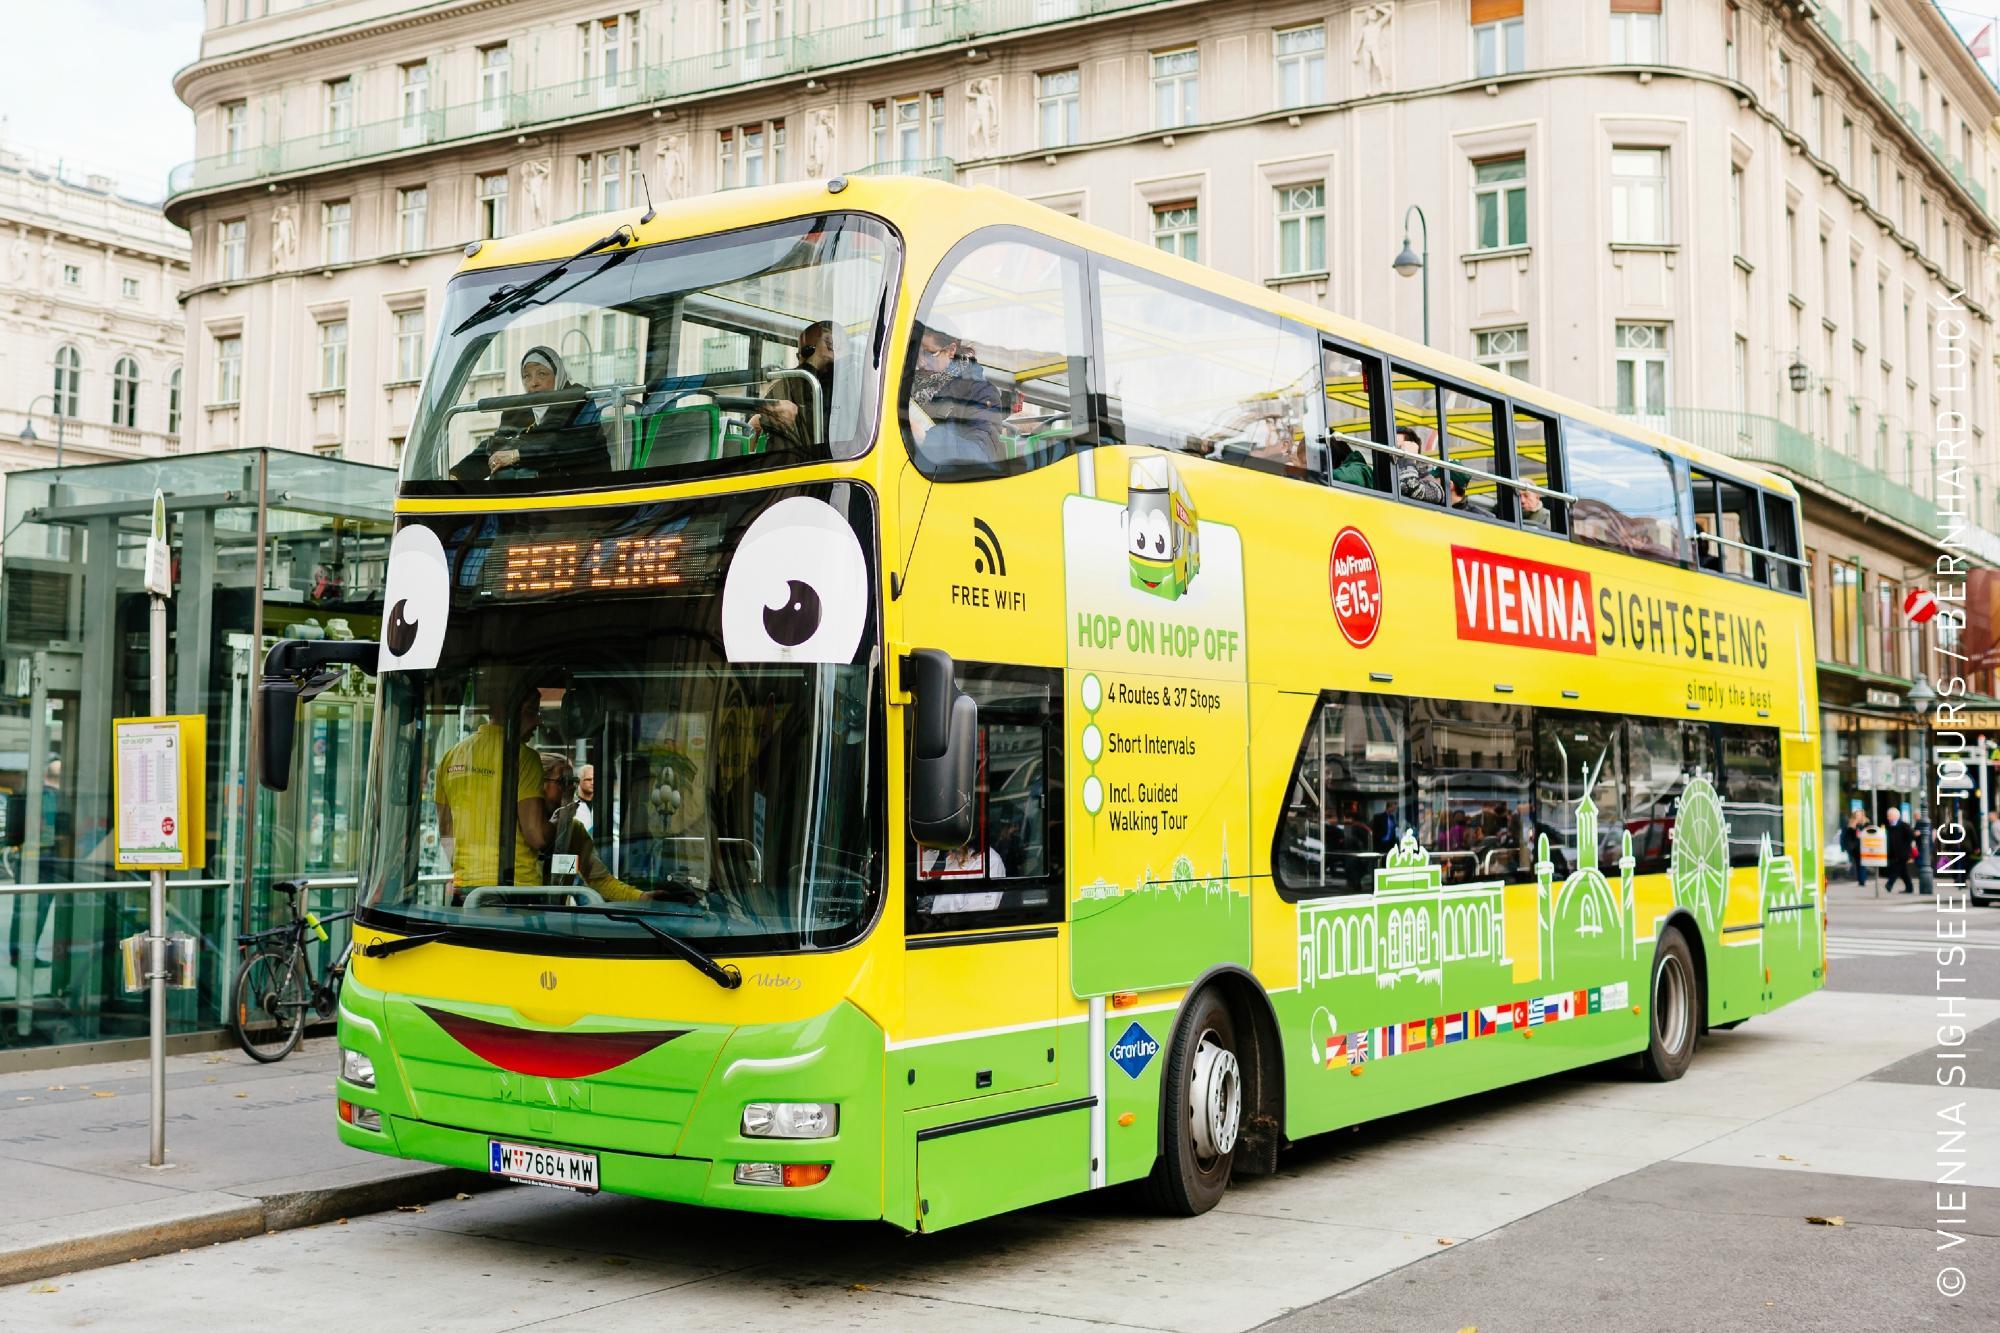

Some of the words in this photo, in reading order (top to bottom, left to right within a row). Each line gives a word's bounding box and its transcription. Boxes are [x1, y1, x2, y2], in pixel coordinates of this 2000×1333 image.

[506, 545, 577, 591] RED
[591, 538, 683, 587] LINE
[1335, 555, 1373, 577] Ab/From
[951, 584, 990, 608] FREE
[994, 589, 1026, 612] WIFI
[1456, 558, 1592, 644] VIENNA
[1599, 587, 1768, 670] SIGHTSEEING
[1077, 612, 1121, 650] HOP
[1126, 618, 1155, 654] ON
[1160, 622, 1200, 658] HOP
[1203, 628, 1239, 662] OFF
[1107, 682, 1116, 703] 4
[1119, 683, 1160, 706] Routes
[1163, 686, 1171, 707] &
[1174, 687, 1188, 708] 37
[1190, 689, 1221, 713] Stops
[1687, 679, 1724, 709] simply
[1728, 683, 1746, 706] the
[1749, 686, 1772, 709] best
[1108, 732, 1142, 754] Short
[1144, 733, 1196, 756] Intervals
[1109, 782, 1135, 803] Incl.
[1138, 782, 1178, 803] Guided
[1108, 810, 1158, 836] Walking
[1160, 810, 1188, 830] Tour
[501, 1147, 512, 1170] W
